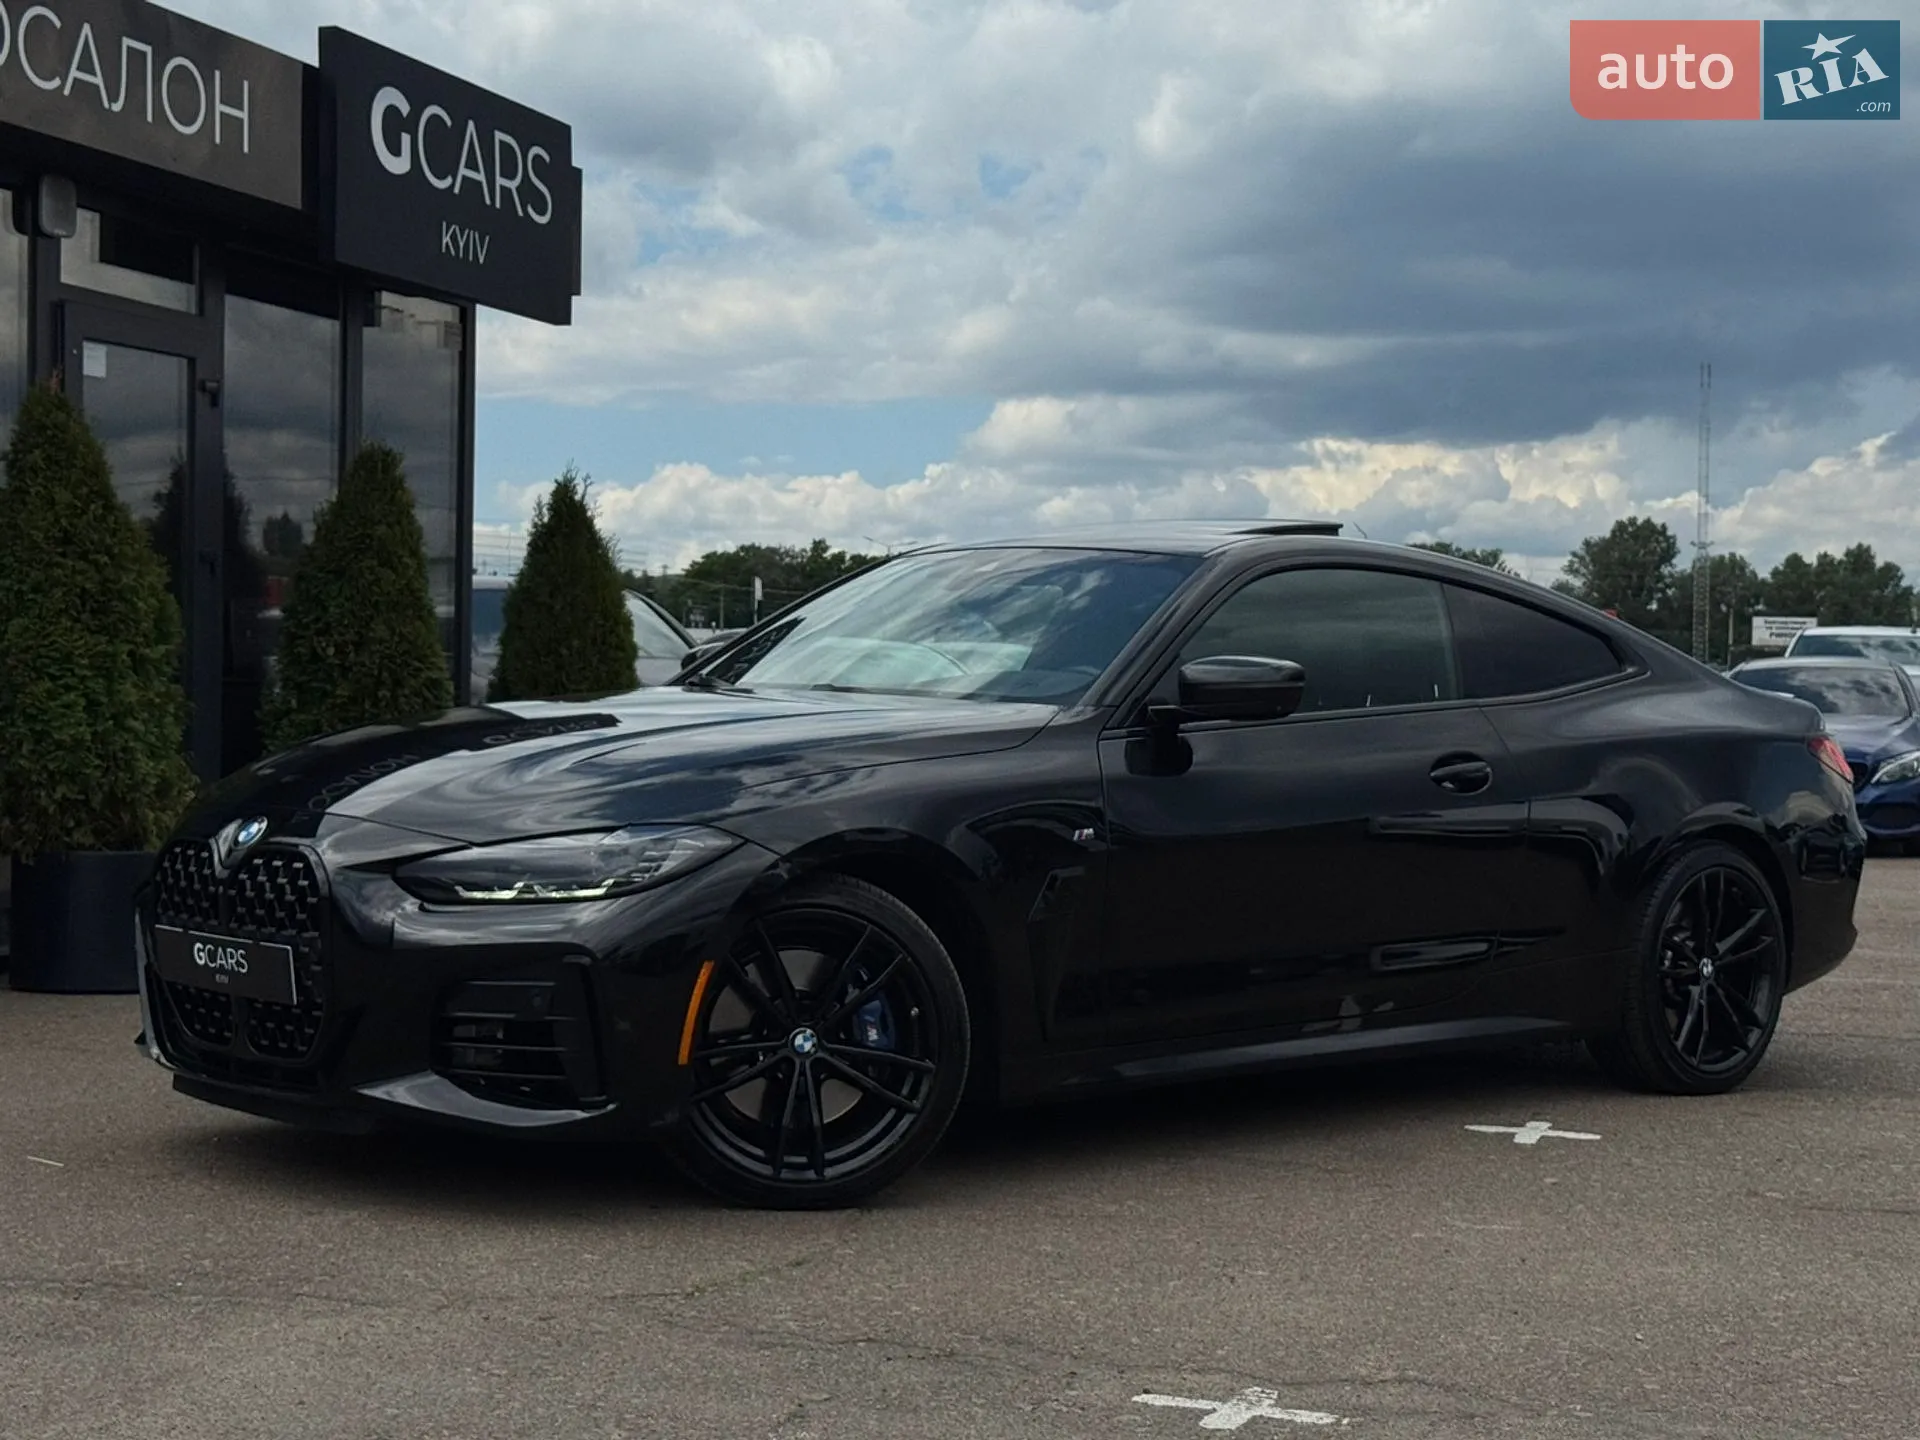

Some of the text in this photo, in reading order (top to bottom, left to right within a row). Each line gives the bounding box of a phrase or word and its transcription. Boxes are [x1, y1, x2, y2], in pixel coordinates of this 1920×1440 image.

[0, 0, 250, 153] САЛОН
[370, 86, 552, 224] GCARS
[441, 220, 490, 265] KYIV
[193, 942, 248, 973] GCARS
